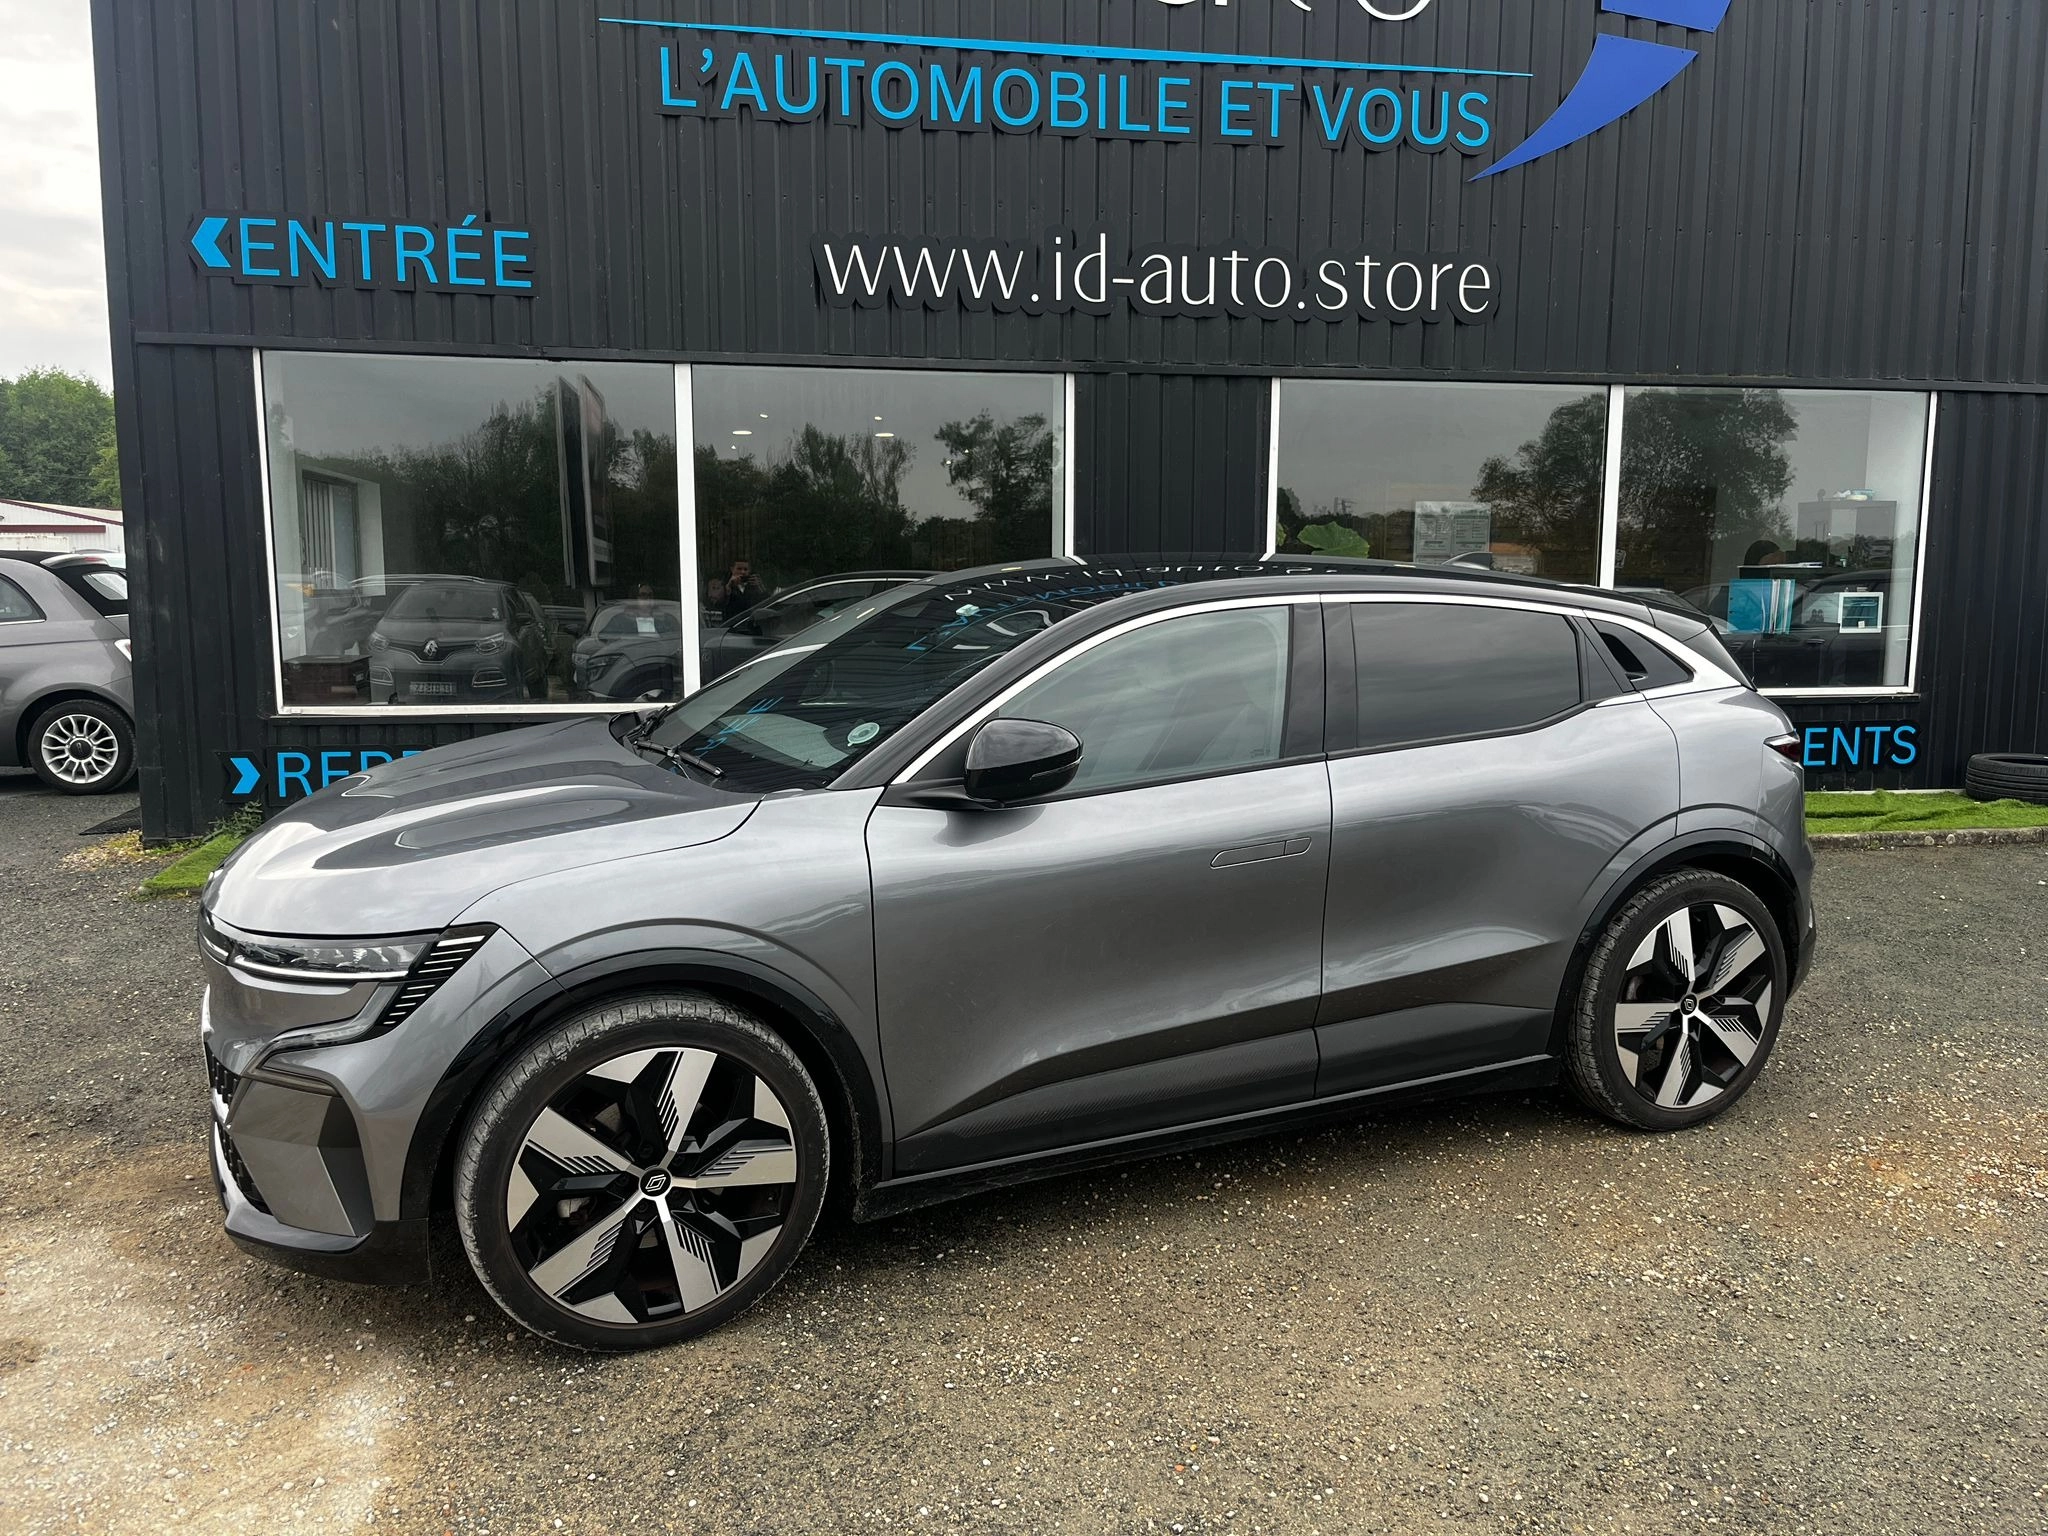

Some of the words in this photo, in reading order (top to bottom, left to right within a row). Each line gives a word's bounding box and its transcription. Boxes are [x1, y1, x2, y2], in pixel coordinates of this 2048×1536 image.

[659, 45, 1192, 135] L'AUTOMOBILE
[1219, 79, 1296, 138] ET
[1312, 84, 1491, 148] VOUS
[238, 213, 533, 289] ENTRÉE
[822, 231, 1493, 315] www.id-auto.store
[1794, 724, 1917, 767] ENTS
